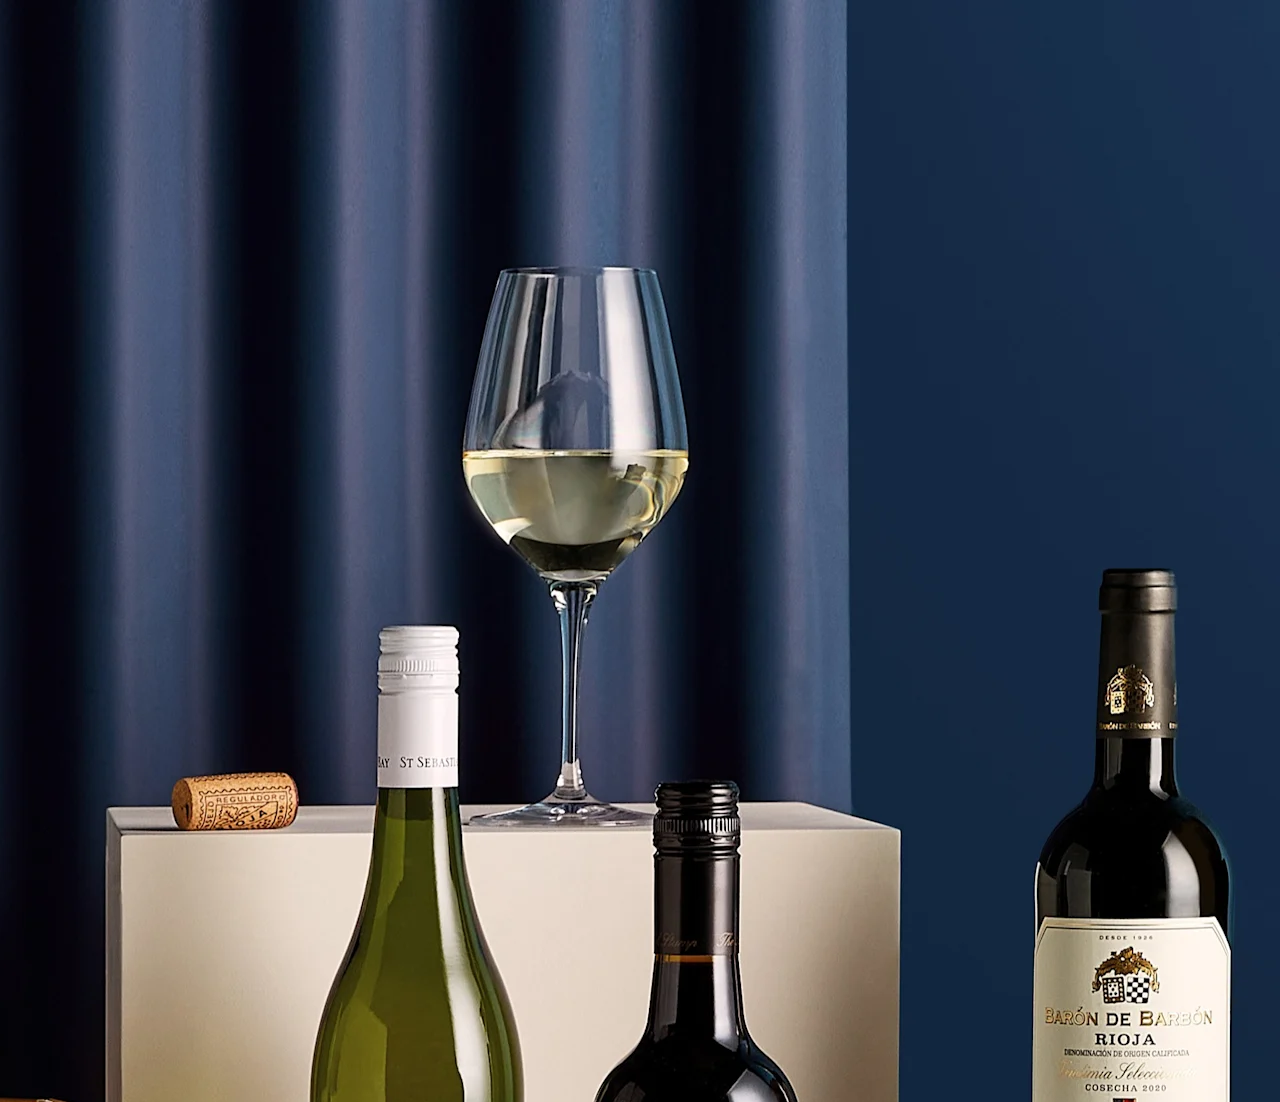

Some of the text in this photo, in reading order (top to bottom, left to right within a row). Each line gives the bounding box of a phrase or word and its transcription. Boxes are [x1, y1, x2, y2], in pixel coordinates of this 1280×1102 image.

[417, 756, 458, 769] SEBASTI
[216, 794, 277, 803] REGULADOR
[1045, 1006, 1213, 1027] BARÓN DE BARBÓN
[1094, 1033, 1157, 1046] RIOJA
[1152, 1049, 1190, 1057] CALIFICADA
[1085, 1083, 1167, 1092] COSECHA 2020
